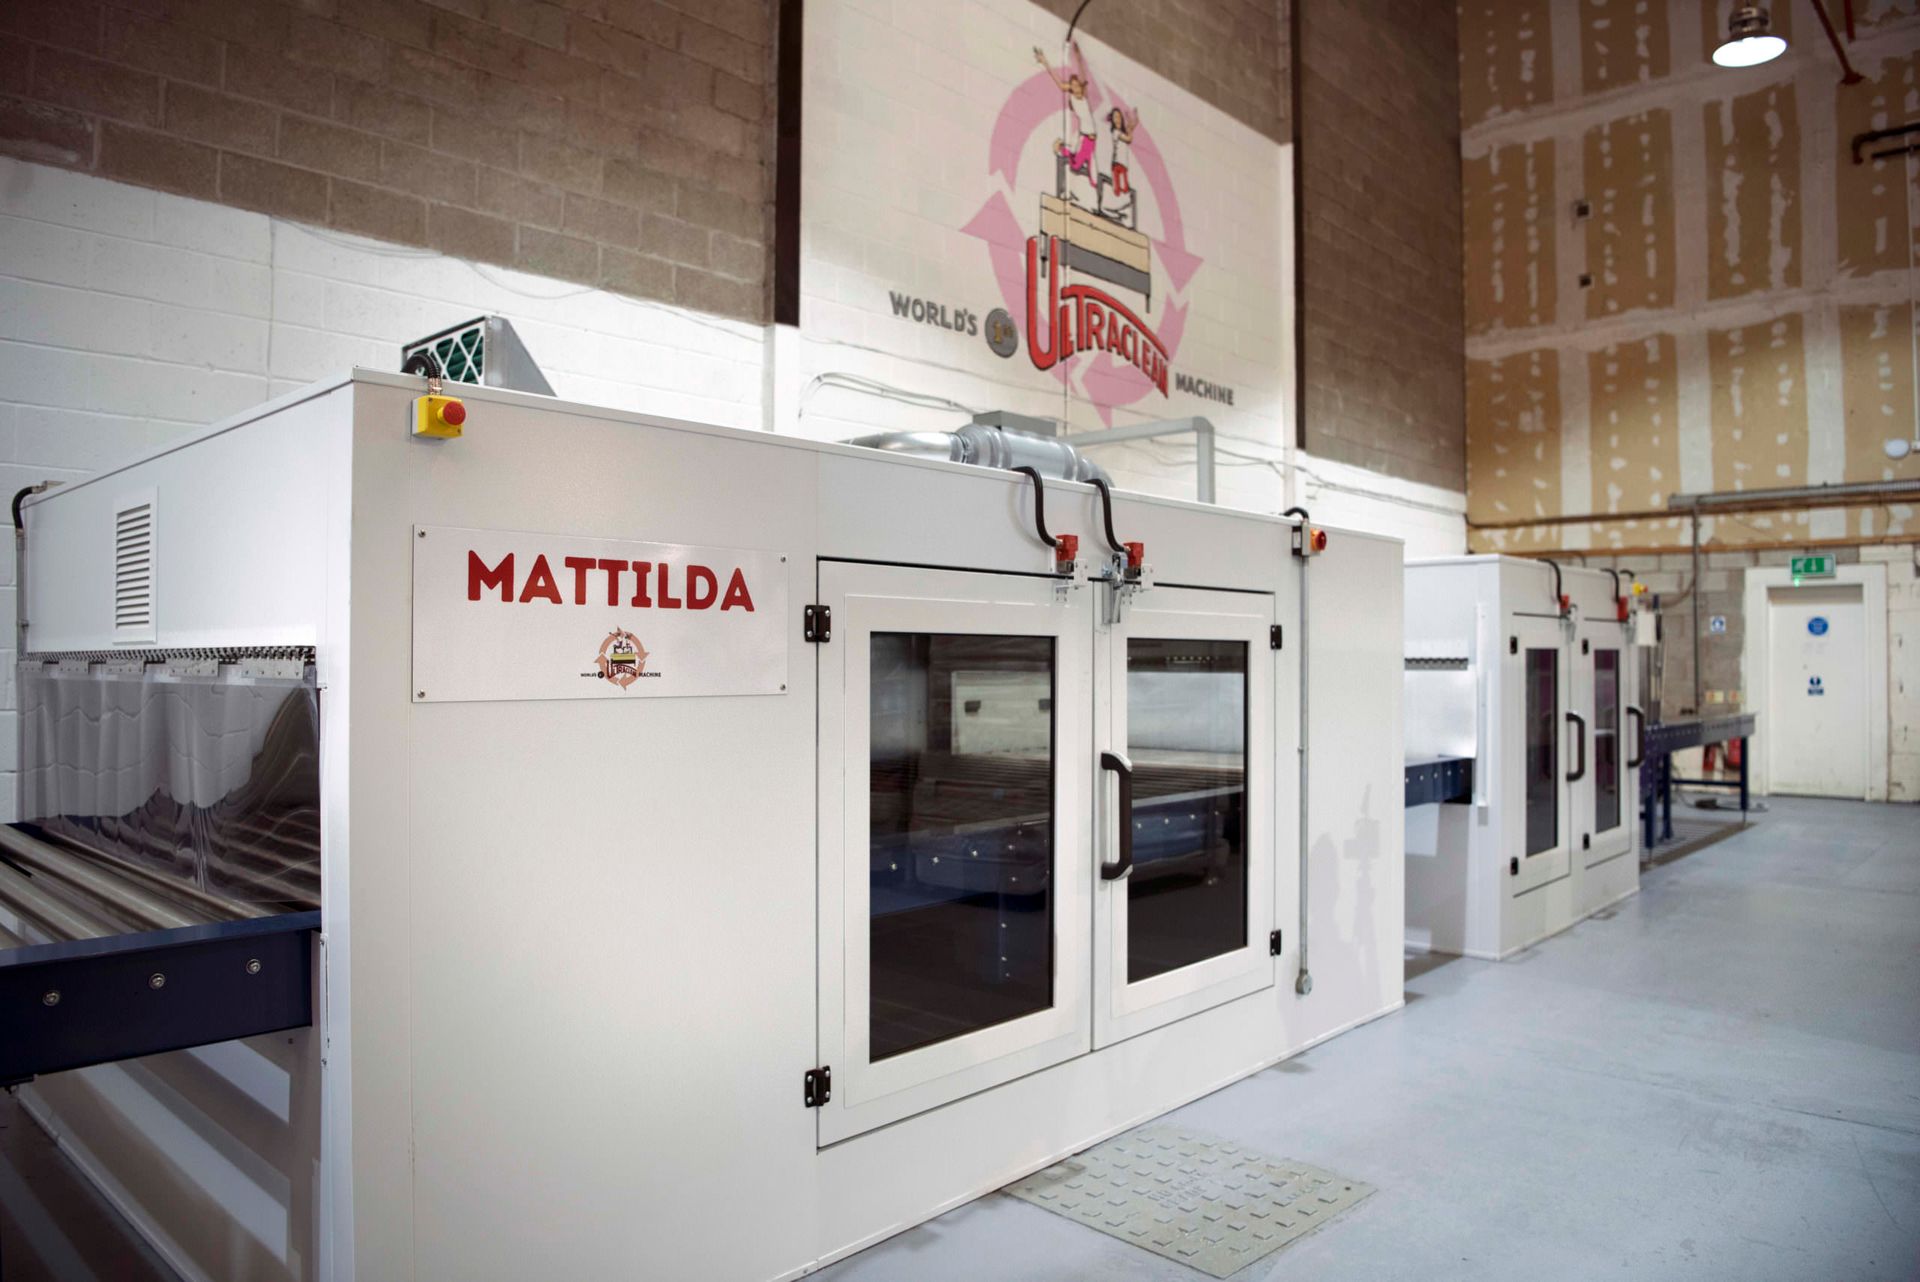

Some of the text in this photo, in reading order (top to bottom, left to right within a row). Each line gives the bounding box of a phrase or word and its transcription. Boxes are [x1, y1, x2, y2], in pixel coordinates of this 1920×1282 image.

[889, 290, 978, 337] WORLD'S
[1026, 234, 1170, 400] ULTRACLEAN
[1175, 372, 1235, 406] MACHINE
[467, 549, 755, 612] MATTILDA
